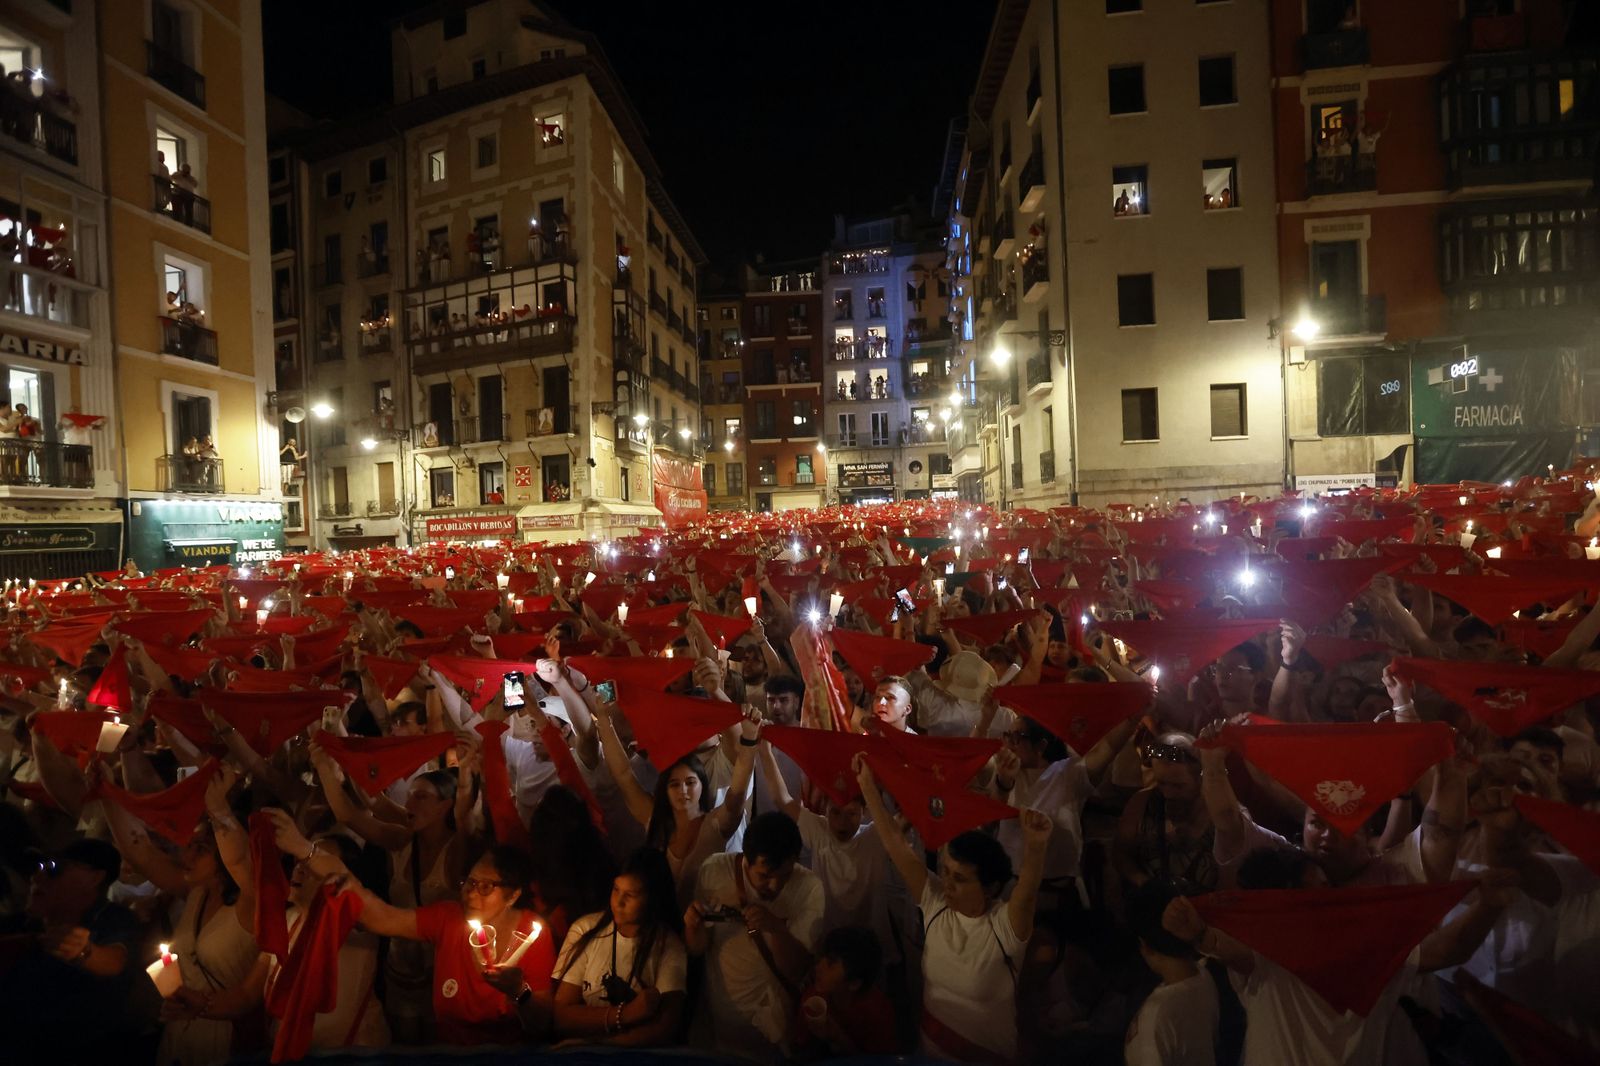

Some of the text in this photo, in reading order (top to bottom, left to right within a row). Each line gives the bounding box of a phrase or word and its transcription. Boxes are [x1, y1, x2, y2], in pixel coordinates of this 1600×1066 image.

[1450, 358, 1477, 378] 0:02
[1455, 404, 1523, 428] FARMACIA
[429, 521, 472, 532] BOCADILLOS
[473, 522, 479, 530] Y
[480, 520, 512, 530] BEBIDAS
[182, 545, 231, 557] VIANDAS
[236, 550, 282, 562] FARMERS
